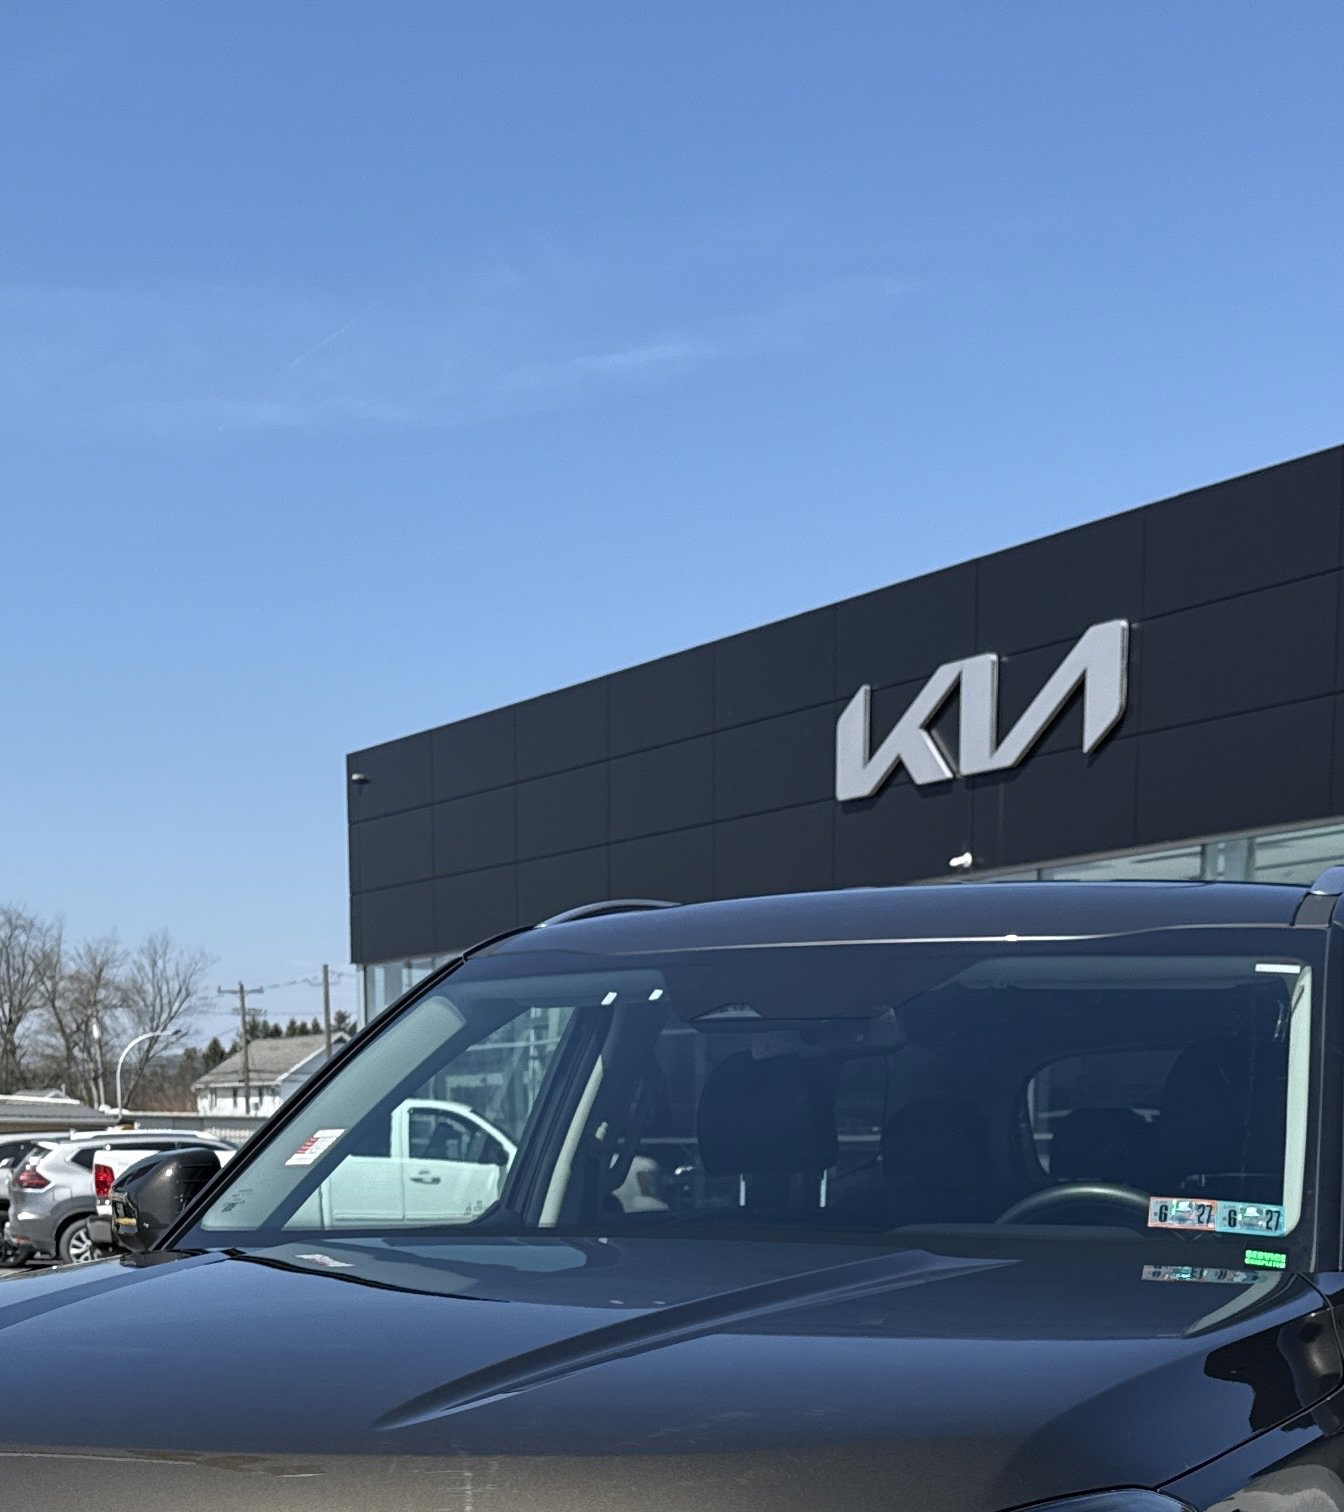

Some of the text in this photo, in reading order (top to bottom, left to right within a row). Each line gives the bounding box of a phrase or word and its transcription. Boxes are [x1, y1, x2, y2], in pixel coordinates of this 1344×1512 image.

[835, 618, 1130, 801] KIA
[1158, 1204, 1213, 1225] 6 27
[1227, 1209, 1281, 1231] 6 27
